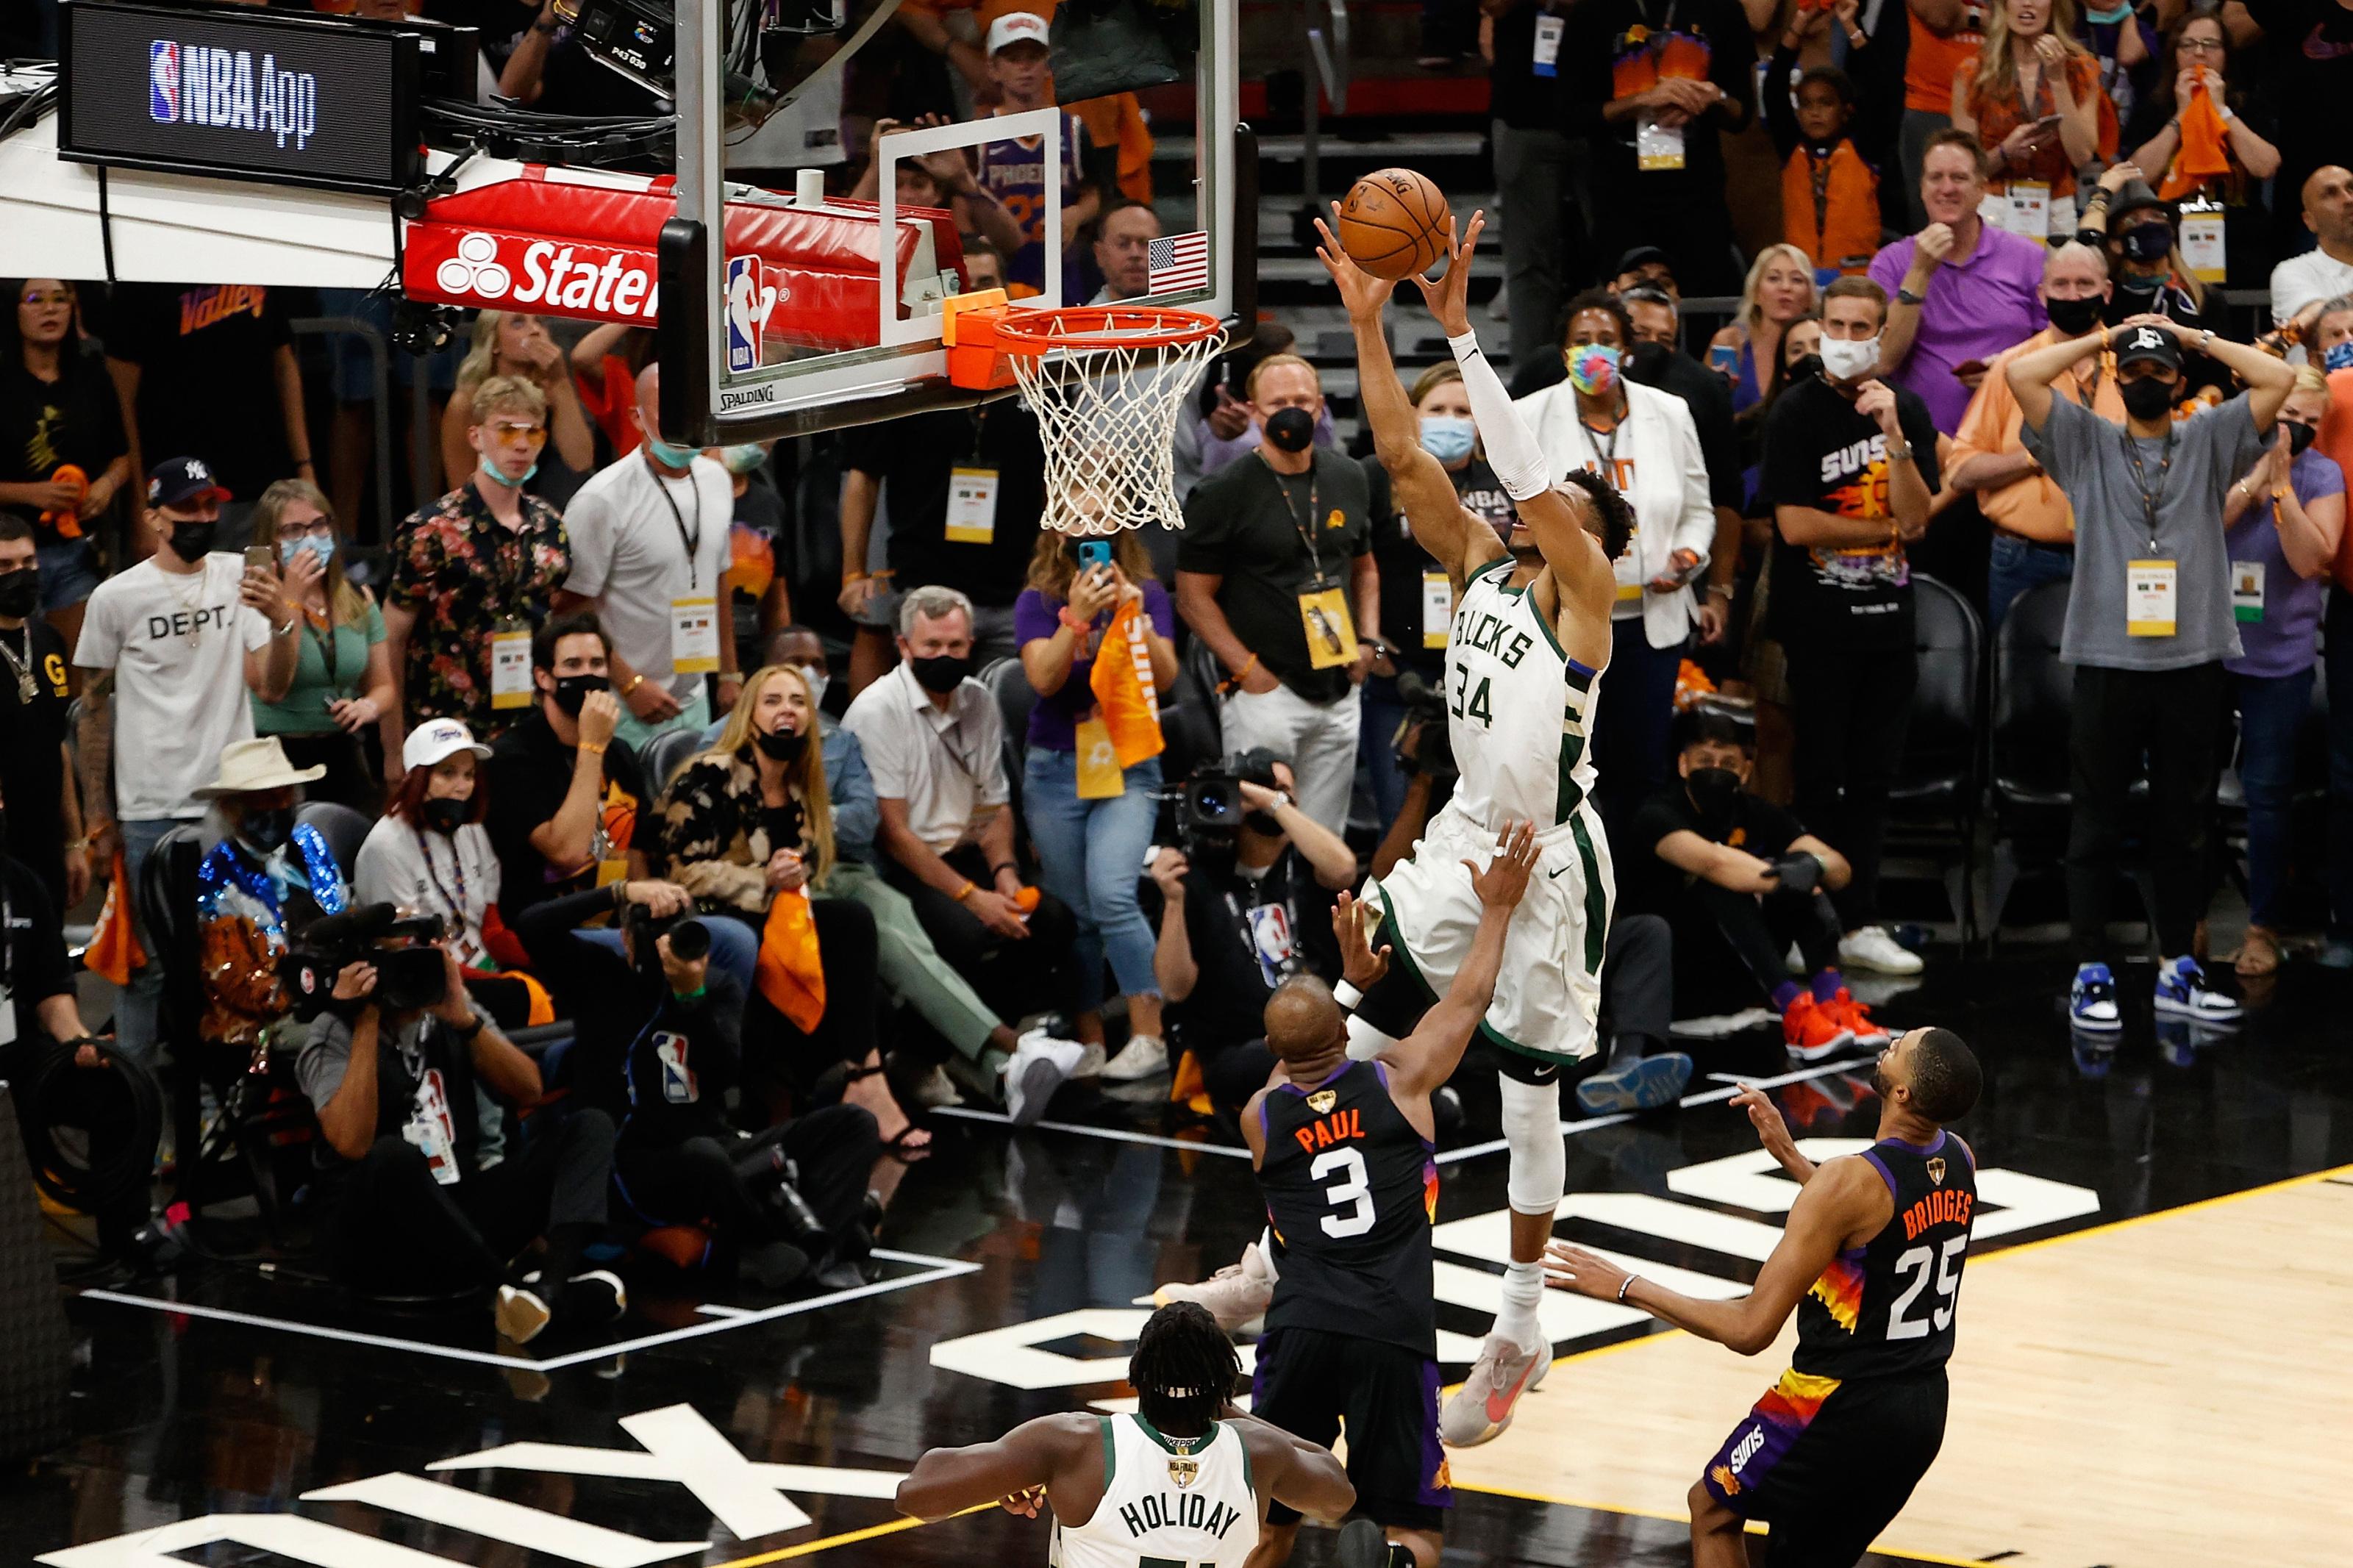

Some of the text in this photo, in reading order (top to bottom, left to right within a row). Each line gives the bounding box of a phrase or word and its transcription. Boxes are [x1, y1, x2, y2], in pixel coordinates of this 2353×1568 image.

[183, 46, 316, 151] NBA App
[513, 242, 648, 317] State
[732, 346, 749, 366] NBA
[720, 384, 774, 412] SPALDING
[1821, 434, 1887, 483] SUNS
[149, 606, 234, 641] DEPT.
[1455, 610, 1534, 670] BUCKS
[1452, 662, 1493, 729] 34
[1295, 1109, 1365, 1153] PAUL
[1310, 1145, 1377, 1239] 3
[1903, 1189, 1973, 1241] BRIDGES
[1886, 1234, 1968, 1340] 25
[1169, 1461, 1179, 1471] NBA
[1730, 1423, 1765, 1475] SUNS
[1119, 1492, 1241, 1541] HOLIDAY
